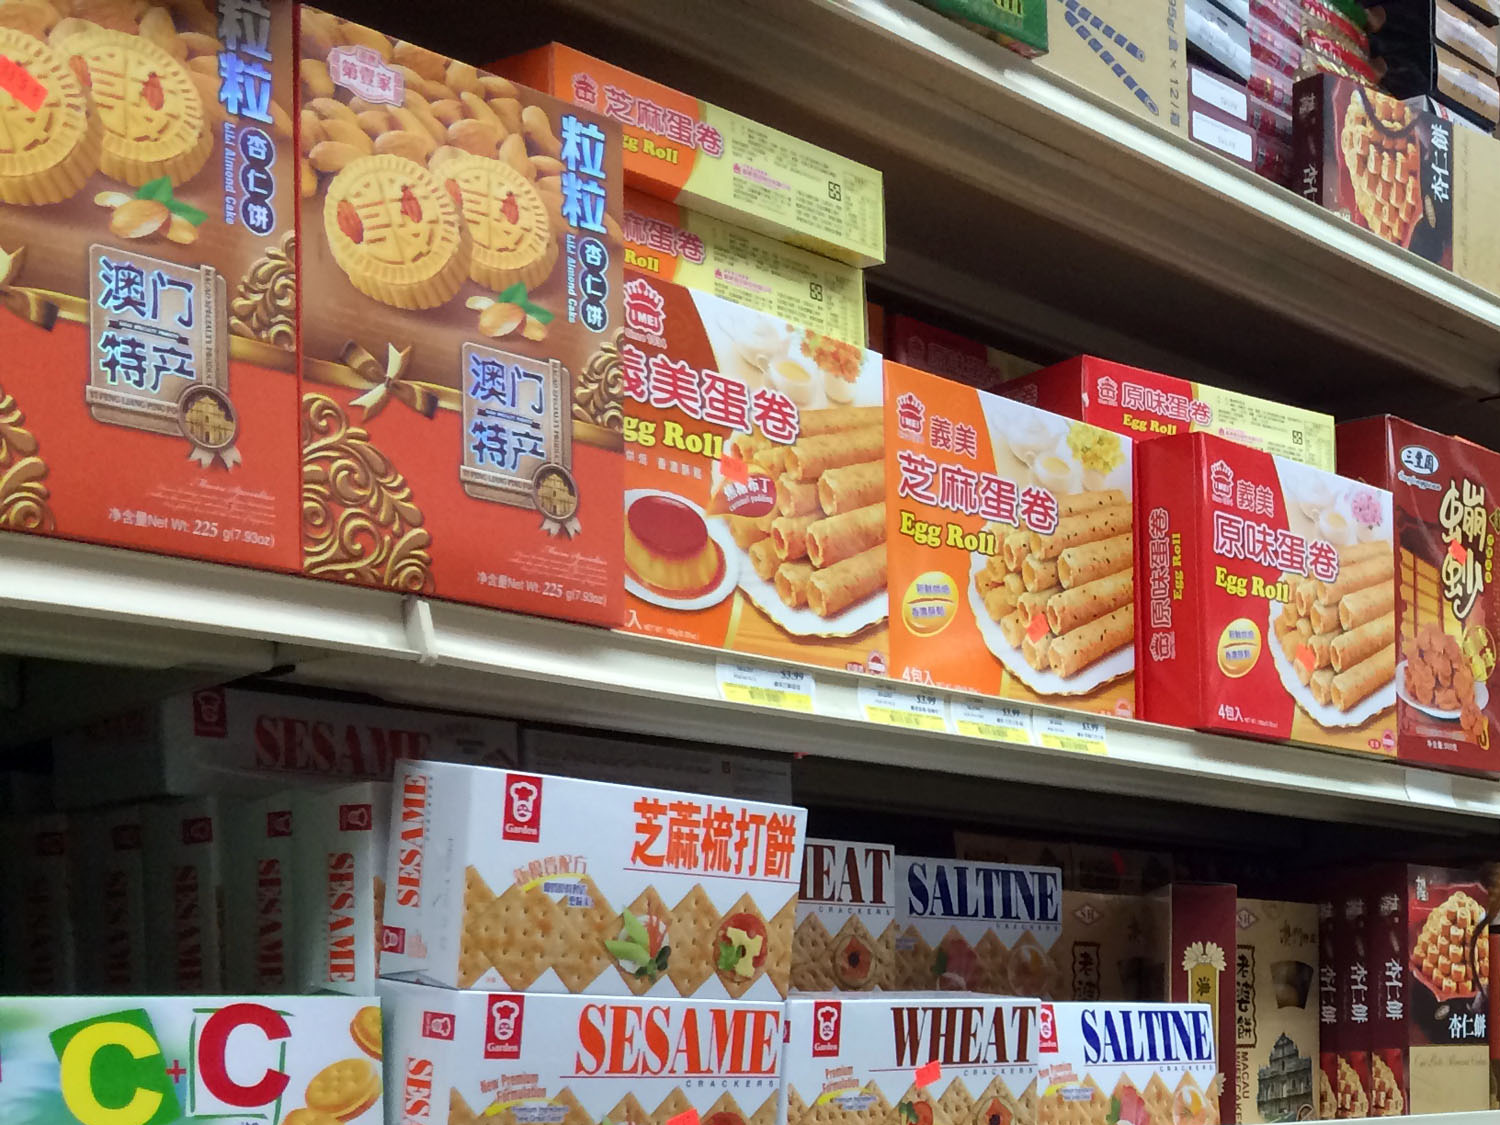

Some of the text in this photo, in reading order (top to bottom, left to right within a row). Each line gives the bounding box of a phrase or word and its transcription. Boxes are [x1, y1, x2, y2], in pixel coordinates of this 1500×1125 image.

[603, 84, 724, 158] 芝麻蛋卷
[561, 114, 607, 234] 粒粒
[643, 138, 679, 164] Roll
[1431, 124, 1450, 204] 杏仁餅
[246, 134, 269, 231] 杏仁饼
[584, 243, 604, 328] 杏仁饼
[624, 250, 660, 273] Roll
[99, 256, 195, 329] 澳门
[98, 331, 196, 392] 特产
[470, 355, 544, 415] 澳门
[624, 344, 798, 446] 義美蛋卷
[1121, 382, 1213, 426] 原味蛋卷
[470, 420, 547, 472] 特产
[624, 415, 723, 460] gg Roll
[931, 416, 977, 458] 義美
[1123, 414, 1177, 435] Egg Roll
[898, 451, 1059, 534] 芝麻蛋卷
[1237, 480, 1274, 517] 義美
[192, 519, 219, 538] 225
[901, 511, 996, 556] Egg Roll
[1214, 511, 1339, 582] 原味蛋卷
[542, 581, 563, 598] 225
[1149, 507, 1171, 628] 原味蛋卷
[1172, 533, 1184, 600] Egg Roll
[1215, 566, 1289, 603] Egg Roll
[902, 667, 935, 687] 4包入
[917, 694, 937, 706] $3.99
[1003, 708, 1021, 719] $3.99
[1218, 703, 1244, 723] 4包入
[397, 773, 428, 908] SESAME
[505, 822, 538, 836] Garden
[327, 852, 355, 983] SESAME
[907, 862, 1059, 923] SALTINE
[256, 858, 284, 985] SESAME
[1320, 965, 1337, 1024] 杏仁餅
[1351, 962, 1368, 1024] 杏仁餅
[1385, 958, 1403, 1020] 杏仁餅
[486, 1042, 519, 1054] Garden
[574, 1003, 781, 1077] SESAME
[814, 1042, 838, 1051] Garden
[891, 1006, 1037, 1067] WHEAT
[1080, 1009, 1212, 1064] SALTINE
[1449, 1013, 1487, 1039] 杏仁餅
[198, 1003, 292, 1107] C
[962, 1066, 1035, 1077] CRACKERS
[1159, 1064, 1214, 1073] CRACKERS
[686, 1079, 775, 1088] CRACKERS
